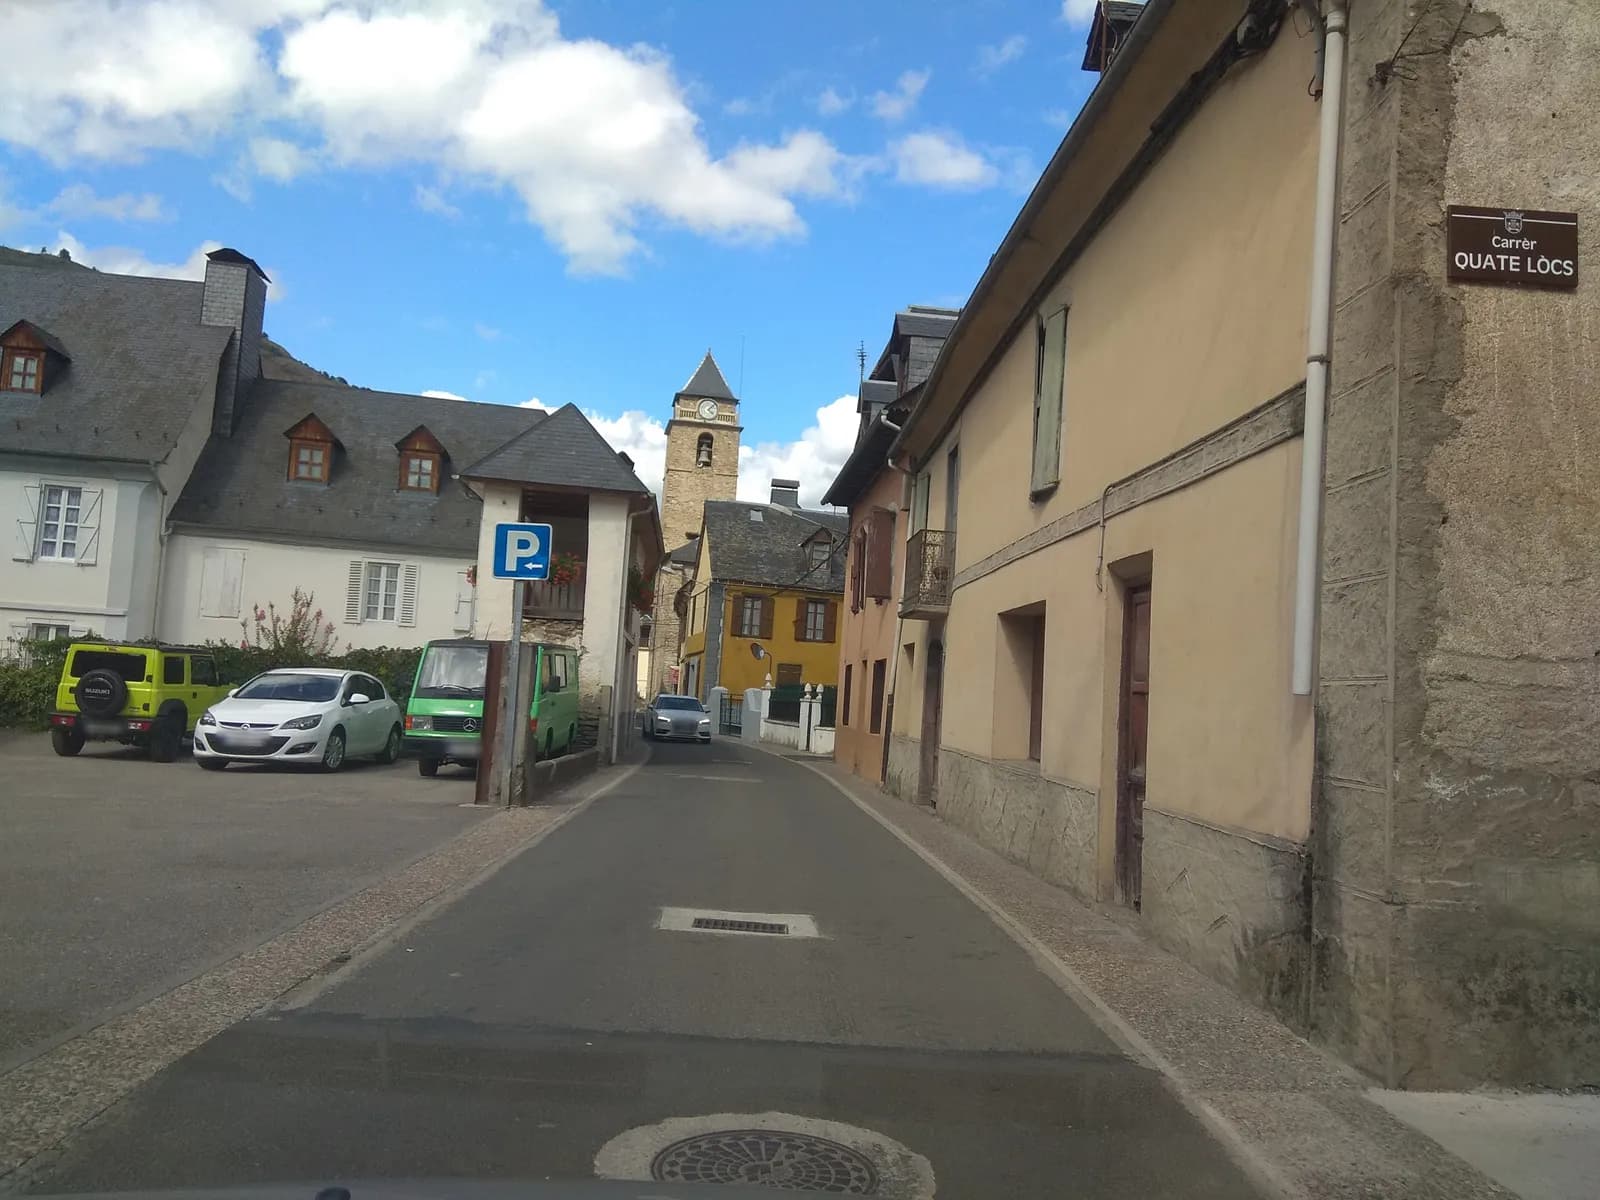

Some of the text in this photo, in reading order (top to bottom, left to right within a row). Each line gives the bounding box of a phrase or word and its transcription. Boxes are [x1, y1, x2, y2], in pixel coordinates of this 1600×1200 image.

[1492, 235, 1537, 250] Carrèr
[1454, 251, 1574, 276] QUATE LÒCS
[505, 530, 540, 571] P
